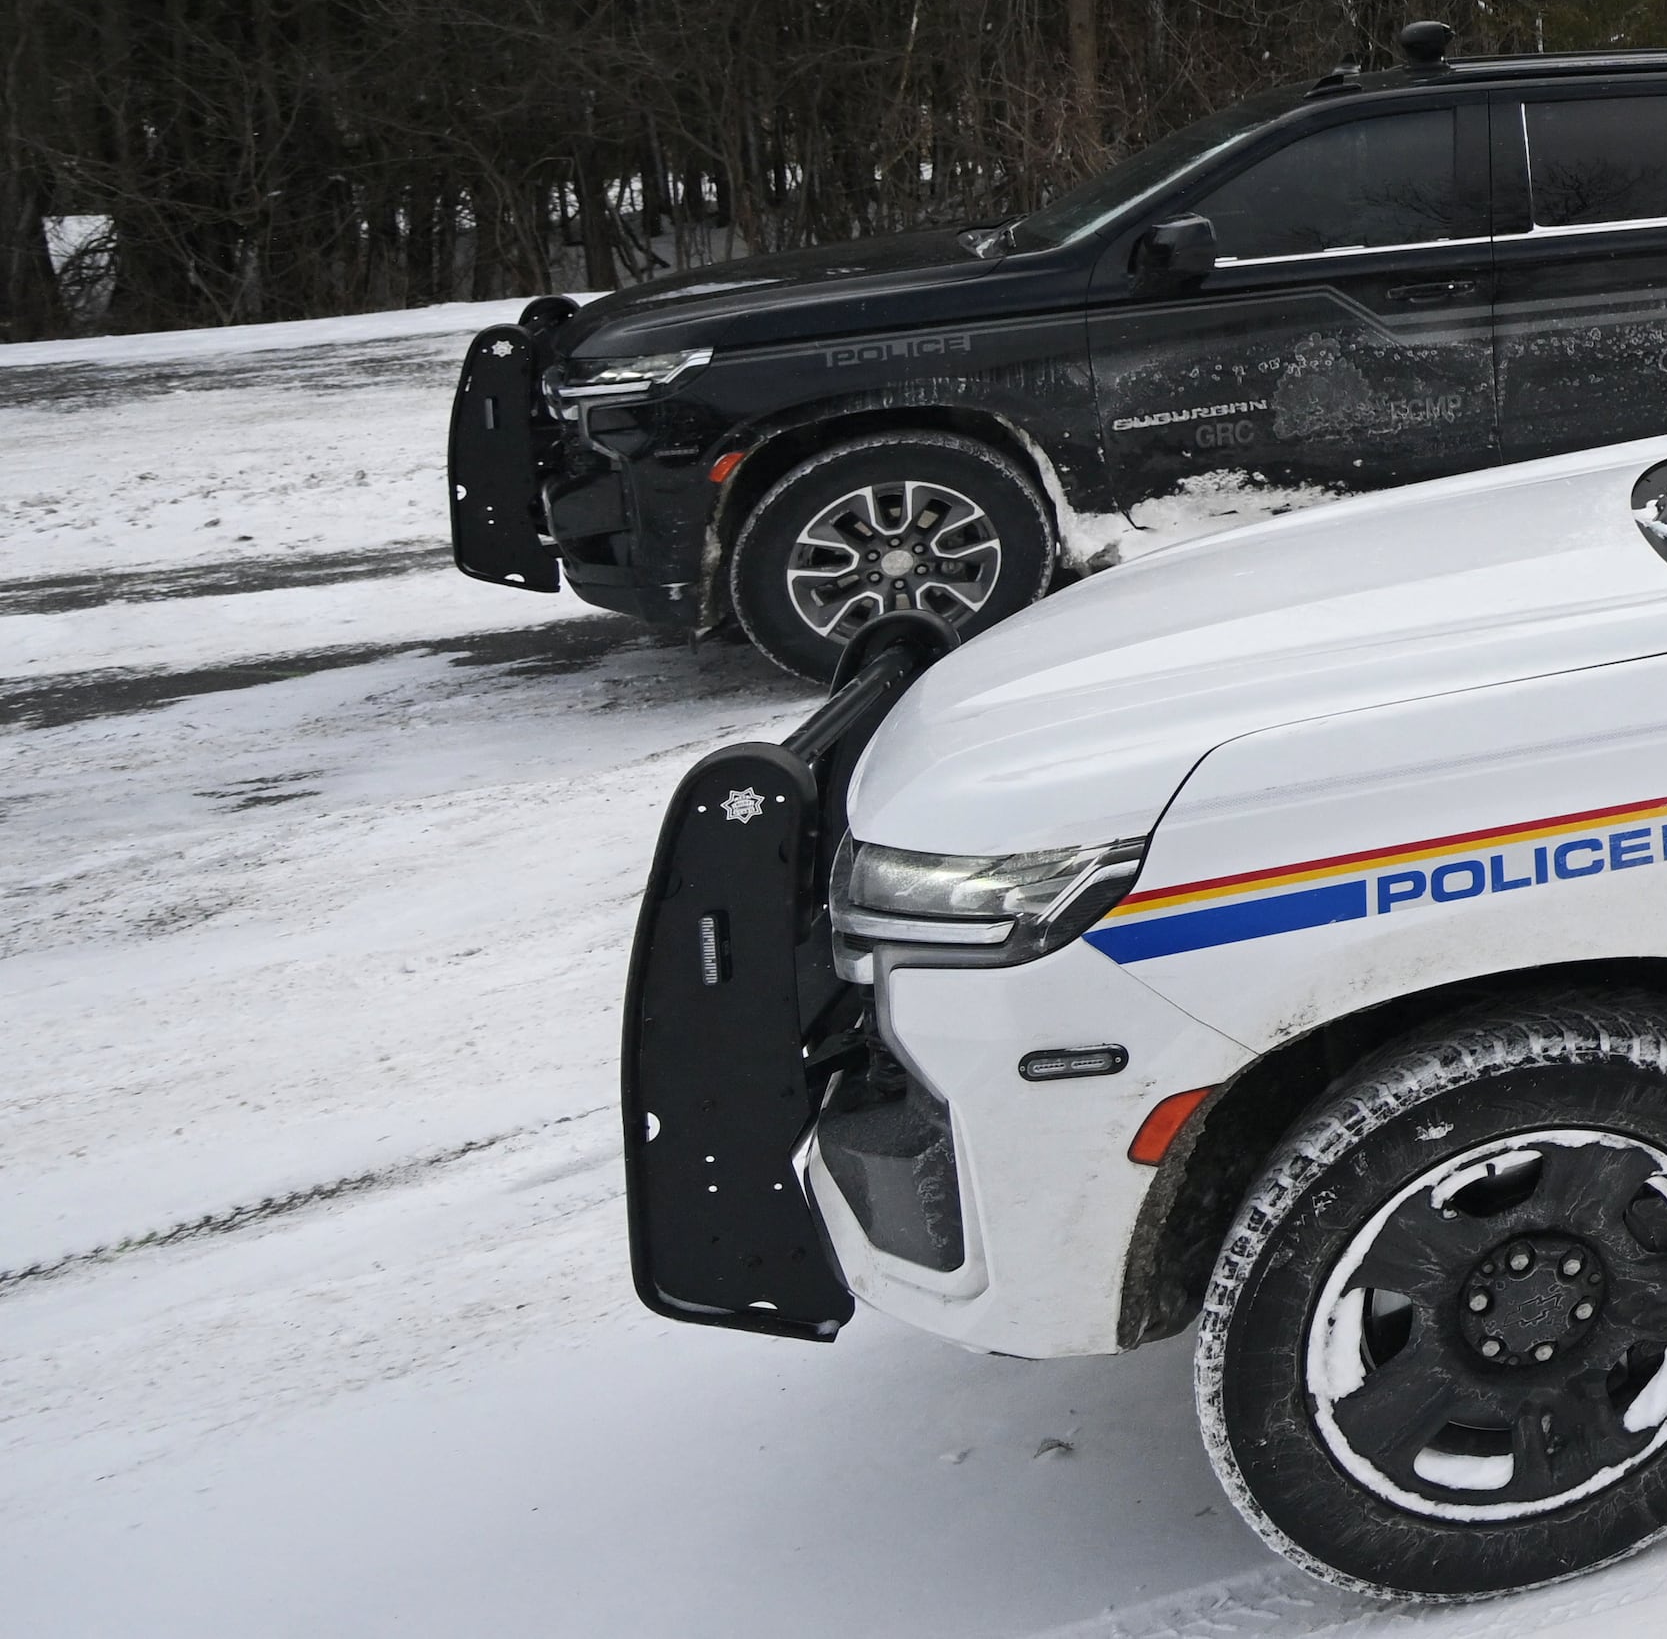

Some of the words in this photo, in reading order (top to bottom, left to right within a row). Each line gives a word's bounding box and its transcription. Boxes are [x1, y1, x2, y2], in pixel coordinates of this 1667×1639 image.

[830, 334, 967, 367] POLICE
[1112, 398, 1268, 431] SUBURBAN
[1195, 419, 1254, 449] GRC
[1376, 827, 1654, 915] POLICE
